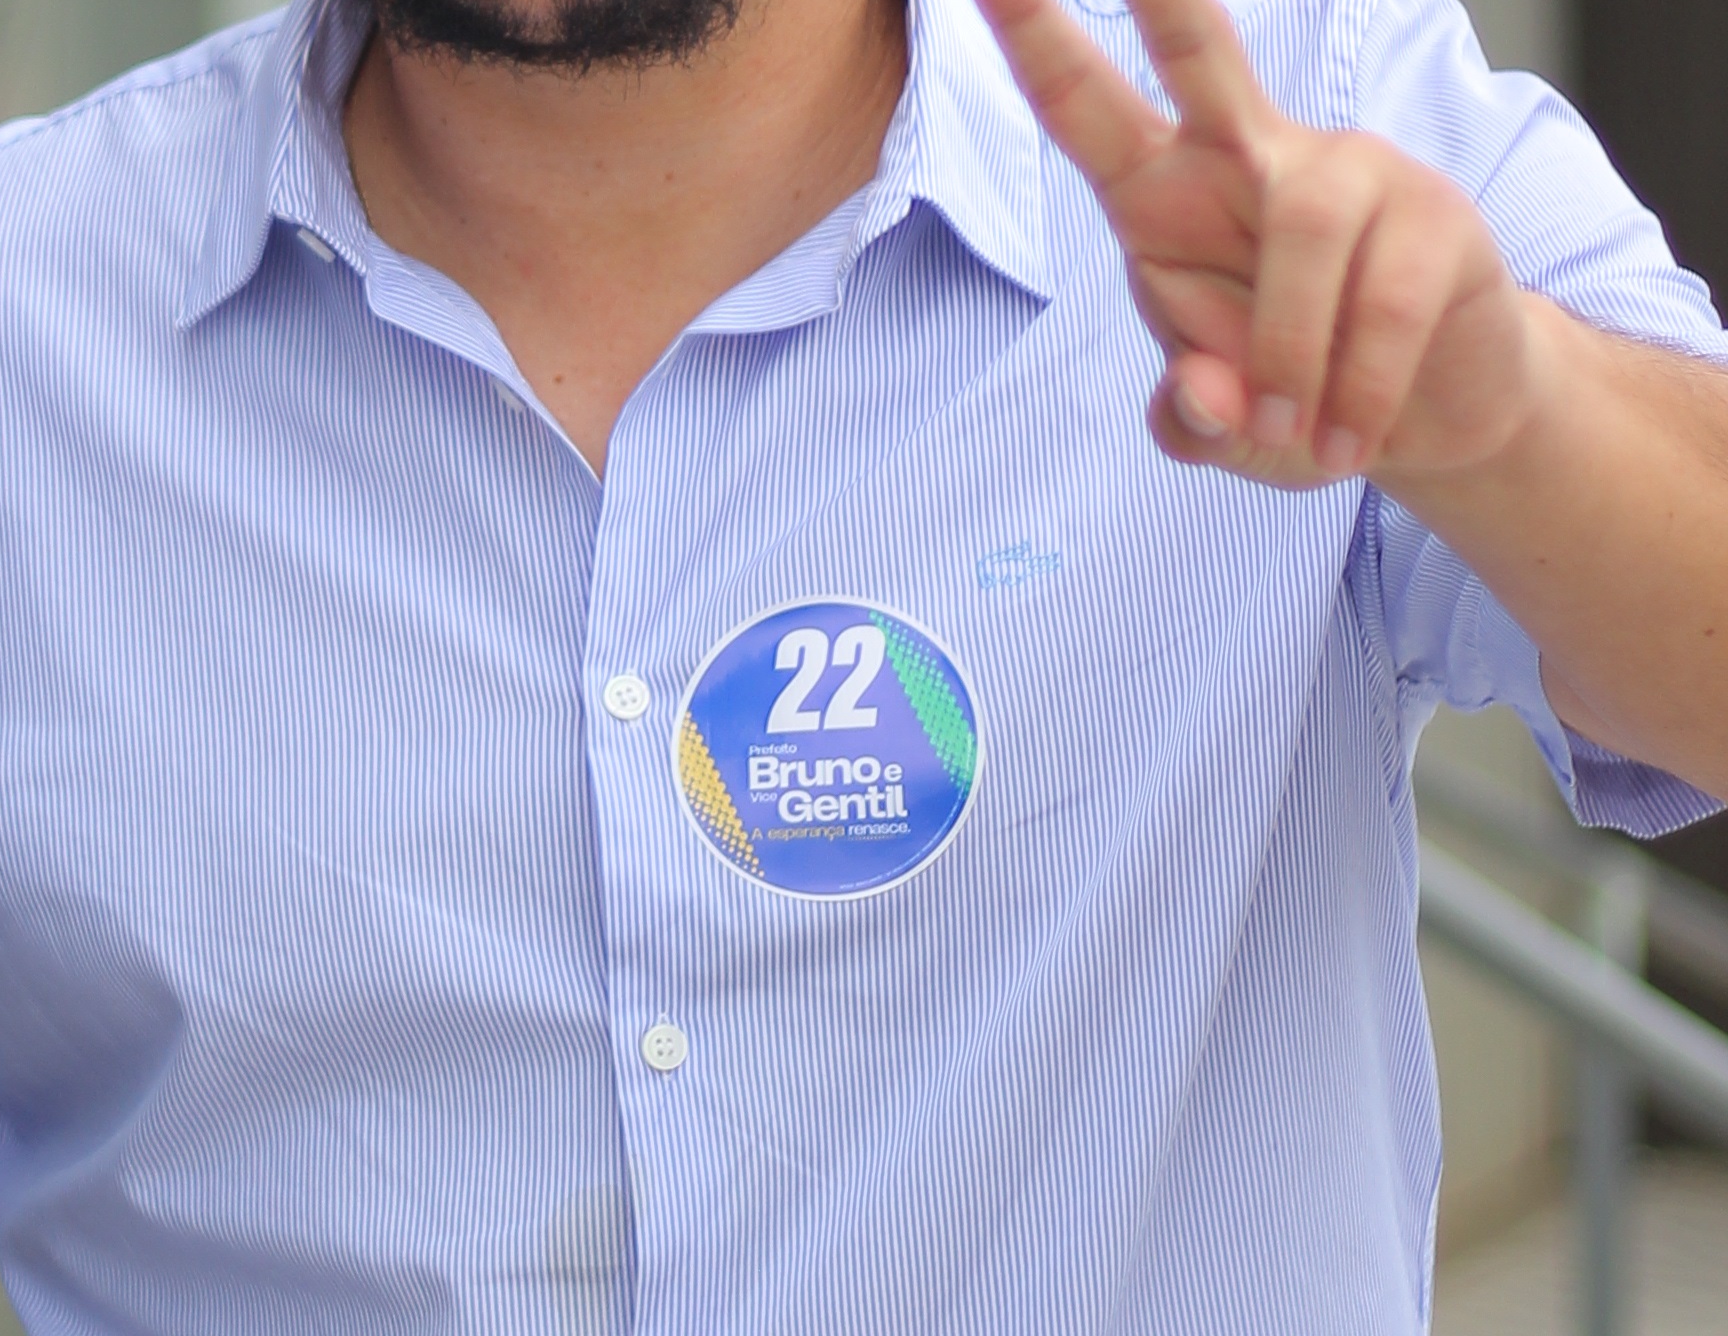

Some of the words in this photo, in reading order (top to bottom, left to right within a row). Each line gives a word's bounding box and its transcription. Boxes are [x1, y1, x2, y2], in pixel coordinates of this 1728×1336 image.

[766, 625, 886, 734] 22
[748, 743, 798, 756] Prefeito
[748, 756, 881, 790] Bruno
[884, 763, 903, 783] e
[778, 784, 908, 824] Gentil
[751, 828, 763, 840] A
